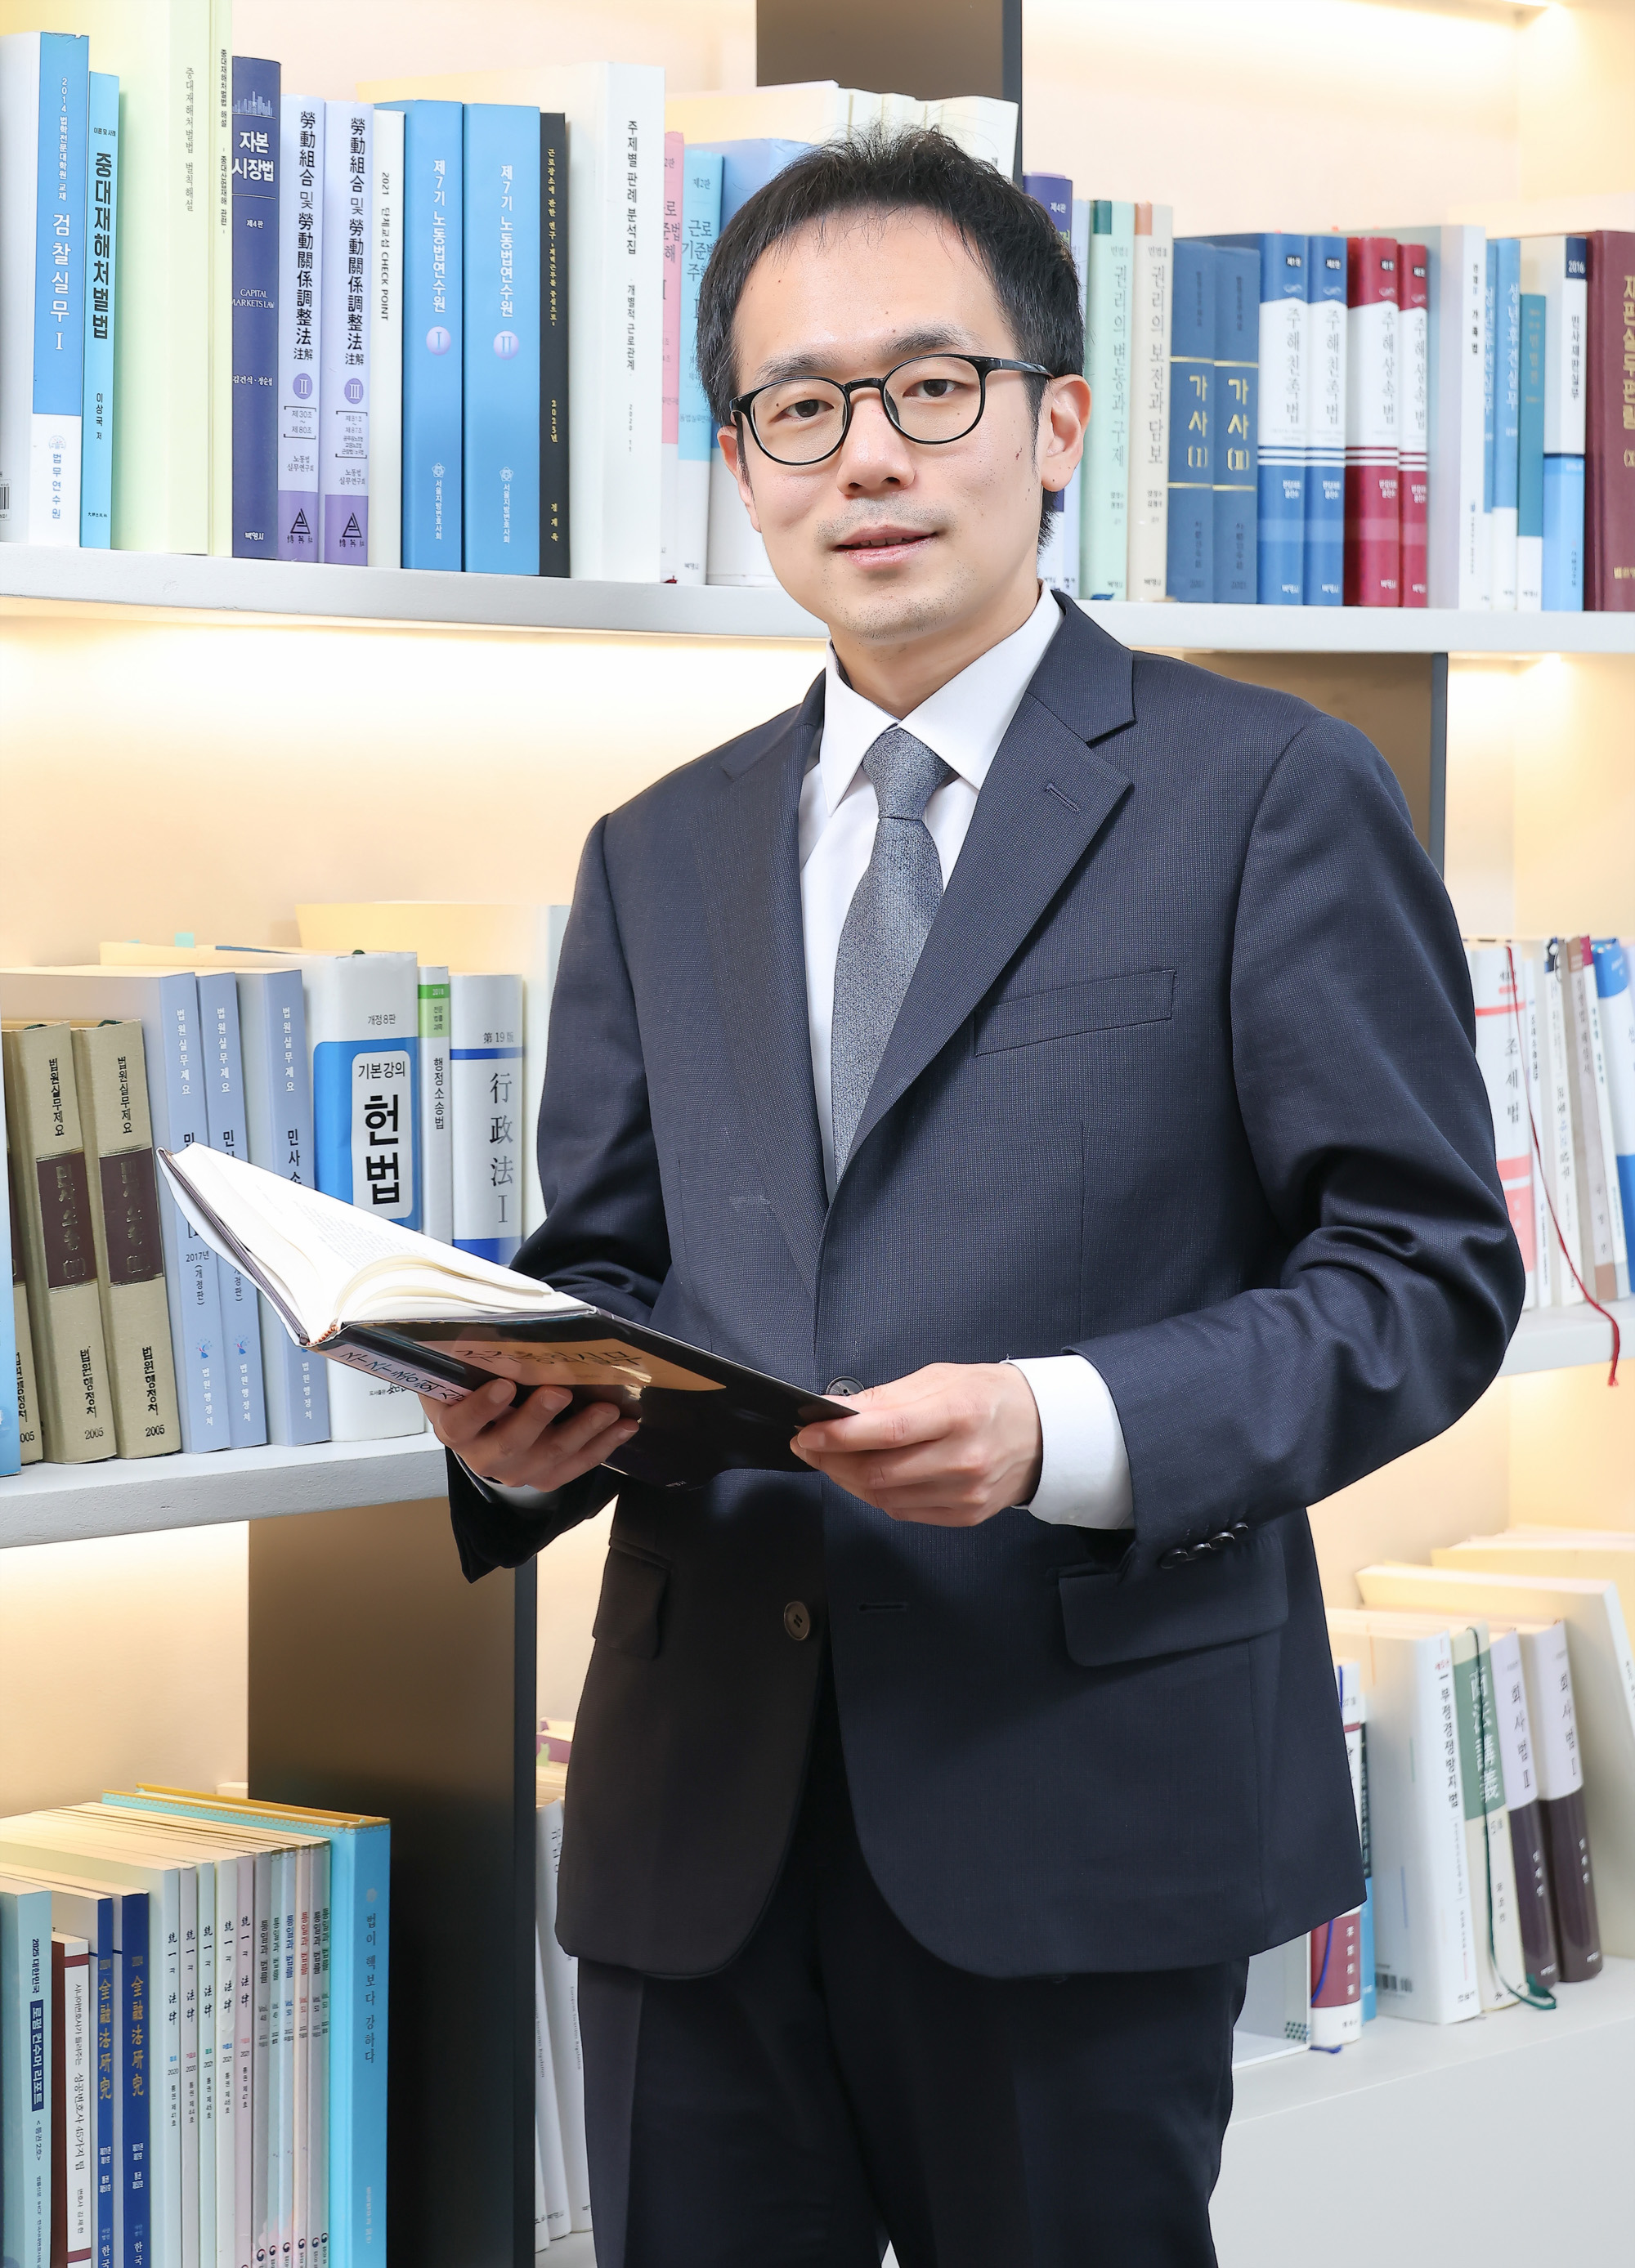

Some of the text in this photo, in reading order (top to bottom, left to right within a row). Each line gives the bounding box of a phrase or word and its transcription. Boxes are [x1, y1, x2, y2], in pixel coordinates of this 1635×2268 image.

[58, 77, 69, 202] 2014 법학전문대학원 교재
[93, 127, 102, 136] 이론
[239, 131, 270, 154] 자본
[299, 111, 316, 187] 勞動組合
[350, 117, 366, 194] 勞動組合
[232, 158, 275, 182] 시장법
[626, 120, 638, 255] 주제별 판례 분석집
[92, 152, 113, 340] 중대재해처벌법
[246, 219, 264, 229] 제4판
[432, 159, 446, 314] 제7기 노동법연수원
[499, 164, 514, 318] 제7기 노동법연수원
[50, 212, 72, 324] 검찰실무
[240, 289, 268, 299] CAPITAL
[296, 212, 314, 346] 勞動關係調整法
[347, 218, 365, 351] 勞動關係調整法
[381, 252, 389, 285] CHECK
[380, 289, 389, 321] POINT
[1113, 265, 1127, 338] 권리의
[1151, 265, 1166, 339] 권리의
[232, 374, 253, 385] 김건식
[1188, 374, 1208, 438] 가사
[1227, 378, 1250, 441] 가사
[96, 392, 104, 441] 이상국 저
[292, 409, 313, 418] 제30조
[292, 426, 313, 434] 제80조
[52, 453, 62, 520] 법무연수원
[217, 1007, 231, 1094] 법원실무제요
[282, 1006, 295, 1093] 법원실무제요
[367, 1013, 396, 1027] 개정8판
[176, 1009, 191, 1096] 법원실무제요
[357, 1061, 406, 1080] 기본강의
[49, 1057, 65, 1138] 법원실무제요
[117, 1055, 133, 1134] 법원실무제요
[433, 1057, 445, 1130] 행정소송법
[364, 1094, 401, 1206] 헌법
[489, 1071, 515, 1188] 行政法
[186, 1250, 210, 1263] 2017년
[80, 1348, 98, 1418] 법원행정처
[142, 1345, 159, 1416] 법원행정처
[202, 1367, 214, 1426] 법원행정처
[240, 1362, 251, 1422] 법원행정처
[301, 1361, 313, 1420] 법원행정처
[84, 1428, 105, 1441] 2005
[146, 1425, 165, 1438] 2005
[365, 1912, 377, 1947] 법이
[31, 1938, 43, 2106] 2025 대한민국 로펌 리포트
[365, 2014, 376, 2064] 강하다
[74, 2073, 85, 2124] 성공변호사
[74, 2127, 85, 2158] 45가지
[75, 2160, 85, 2171] 팁
